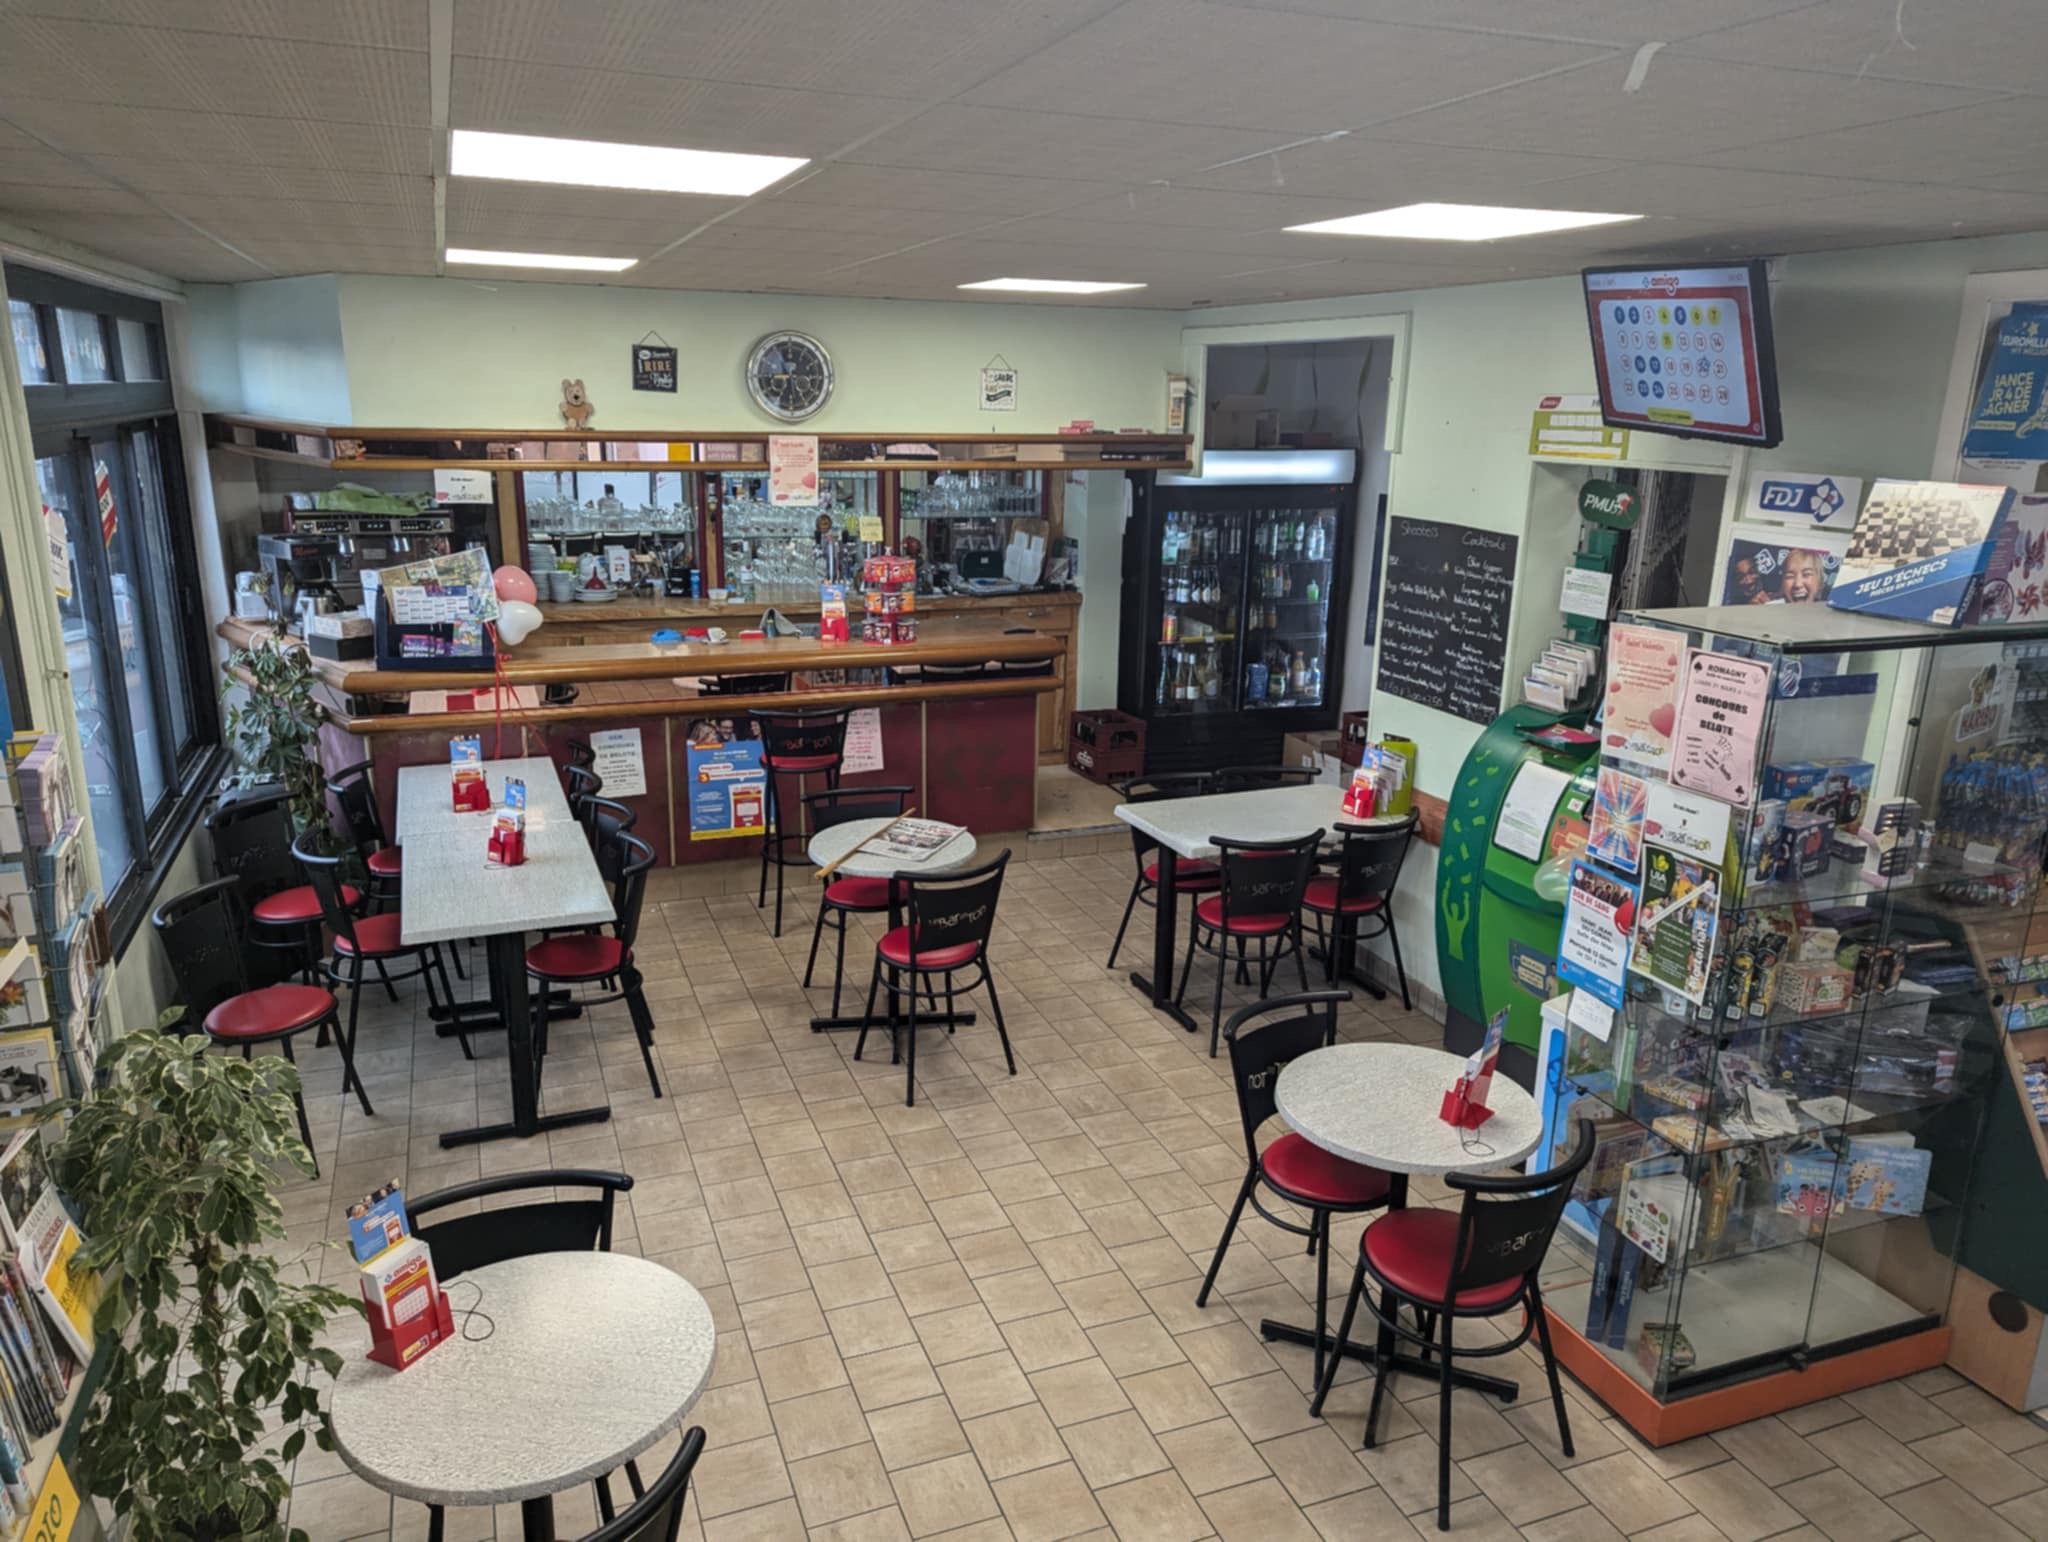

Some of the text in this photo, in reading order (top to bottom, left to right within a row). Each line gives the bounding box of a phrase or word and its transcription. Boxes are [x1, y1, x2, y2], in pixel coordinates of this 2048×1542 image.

[1651, 275, 1680, 296] amigo
[644, 360, 672, 371] RIRE
[2015, 384, 2032, 400] DE
[1584, 493, 1614, 513] PMU
[1762, 486, 1801, 507] FDJ
[1855, 558, 1948, 595] JEU D'ÉCHECS
[1708, 664, 1747, 678] ROMAGNY
[1695, 693, 1749, 715] CONCOURS
[1712, 711, 1725, 721] de
[1699, 719, 1734, 736] BELOTE
[1573, 888, 1610, 914] DON DE SANG
[393, 1255, 422, 1277] amigo
